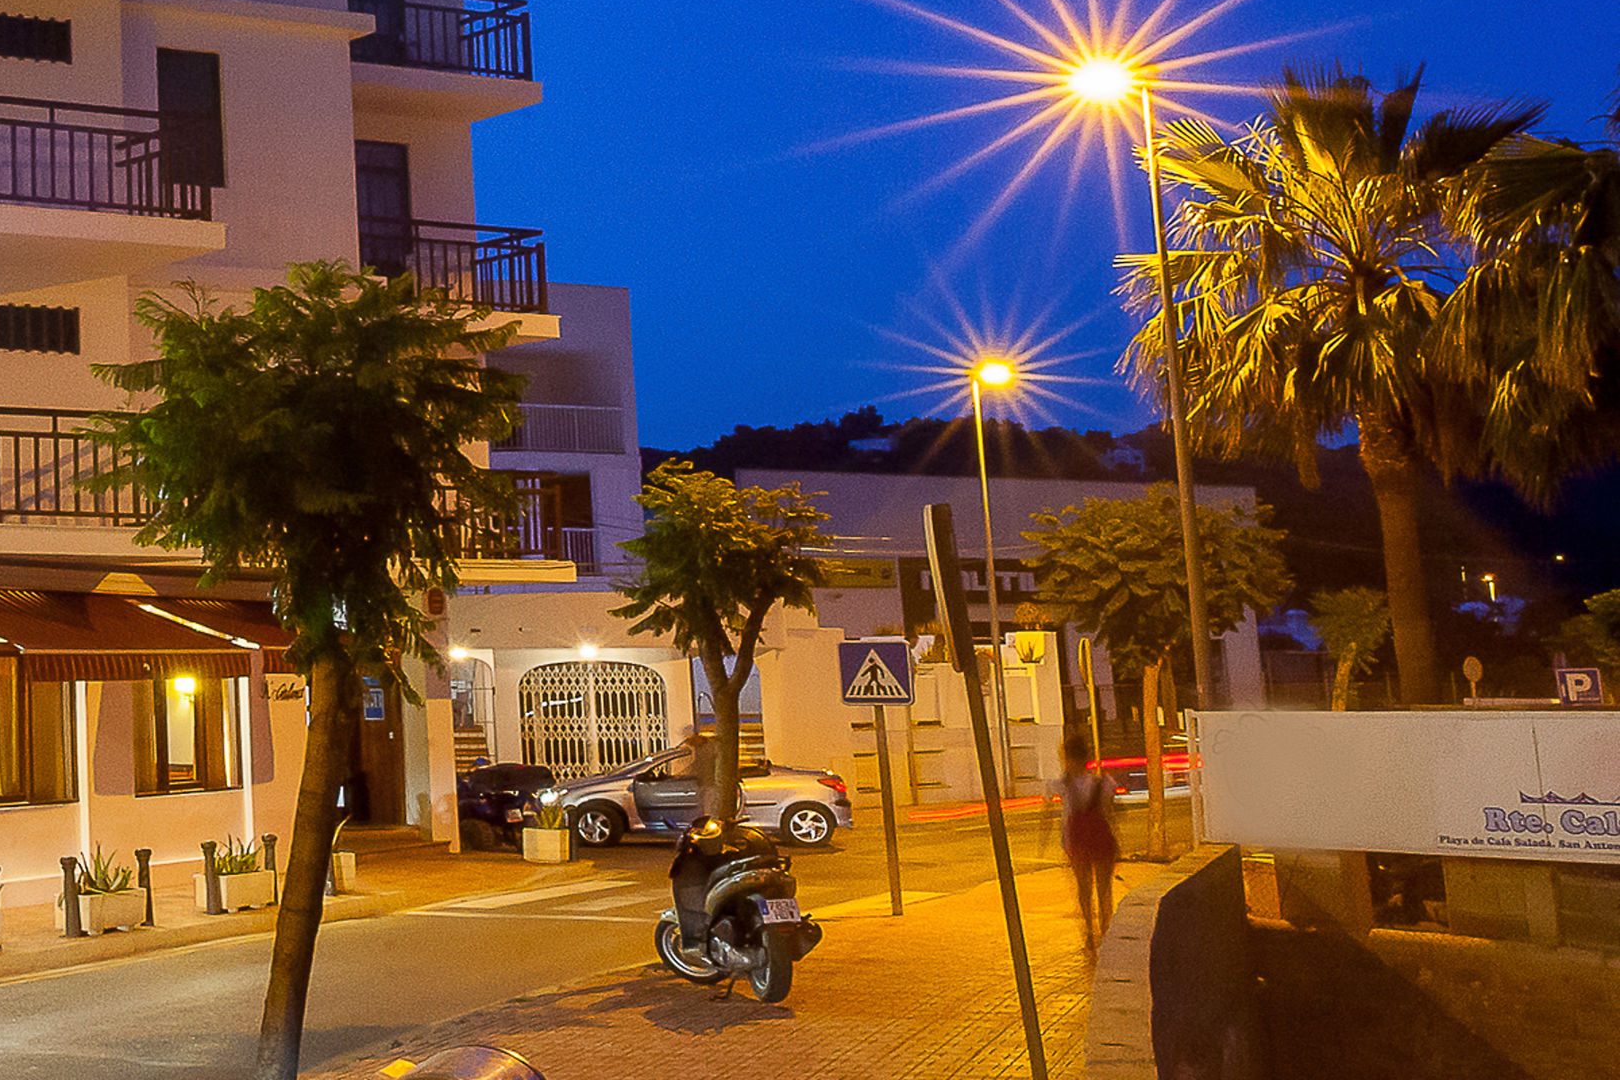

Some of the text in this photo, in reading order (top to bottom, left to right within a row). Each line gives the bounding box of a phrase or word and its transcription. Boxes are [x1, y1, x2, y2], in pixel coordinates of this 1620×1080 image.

[1565, 673, 1593, 702] P
[1482, 806, 1555, 834] Rte.
[1440, 835, 1470, 846] Playa
[1471, 836, 1484, 845] de
[1487, 836, 1512, 846] Cala
[1558, 839, 1581, 849] San
